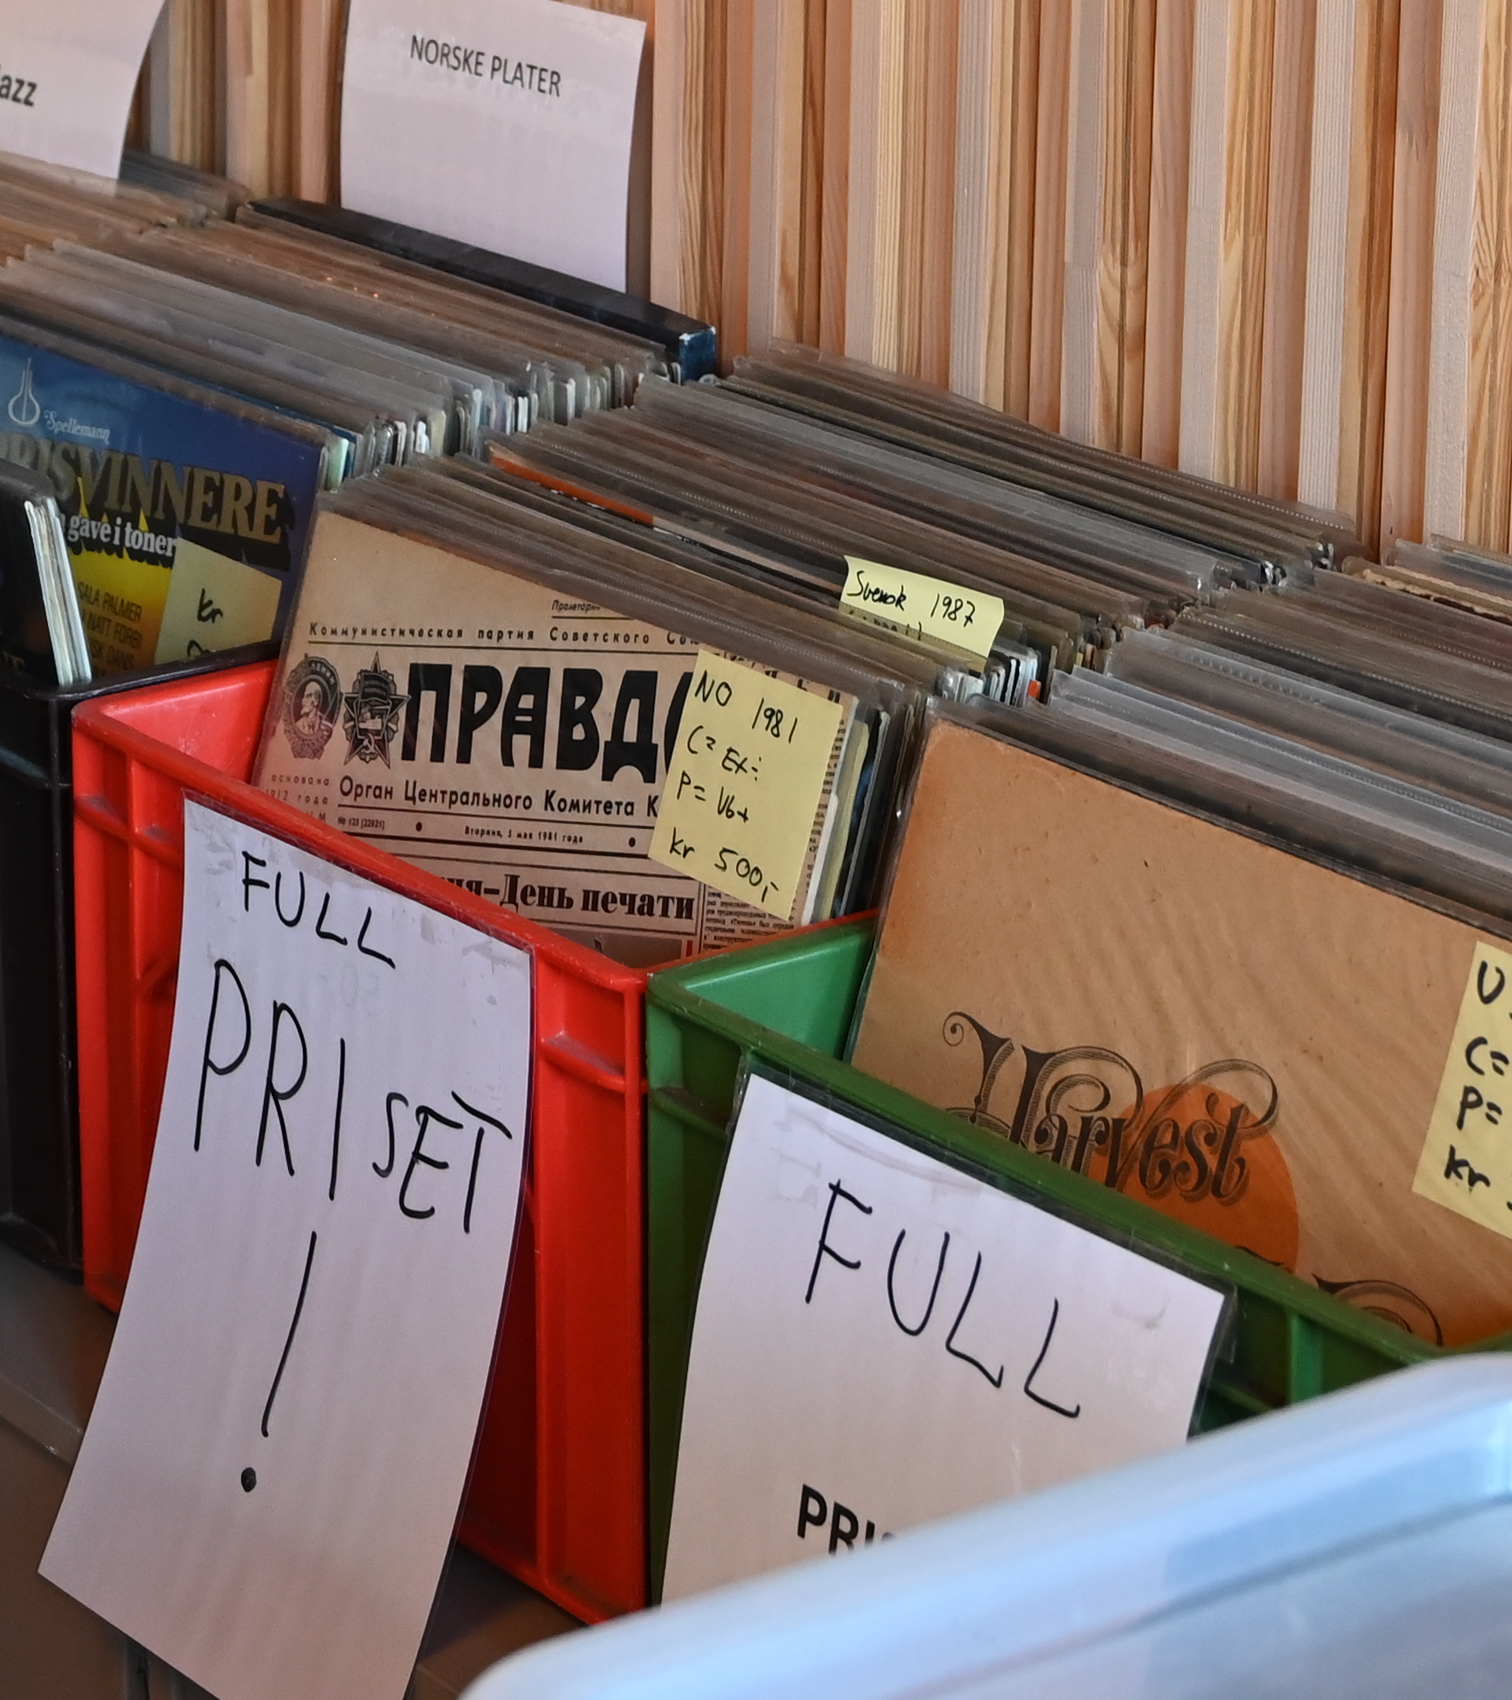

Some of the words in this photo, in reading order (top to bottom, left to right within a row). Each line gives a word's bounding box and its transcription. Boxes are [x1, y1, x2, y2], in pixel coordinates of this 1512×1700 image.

[409, 33, 485, 81] NORSKE
[490, 55, 563, 99] PLATER
[67, 515, 111, 546] gave
[113, 516, 121, 545] i
[125, 521, 176, 558] toner
[930, 593, 976, 628] 1987
[309, 622, 463, 639] Коммунистическая
[478, 627, 535, 643] партия
[549, 627, 650, 645] Советского
[694, 669, 733, 707] NO
[752, 697, 798, 744] 1981
[297, 793, 329, 806] года
[339, 774, 393, 802] Орган
[404, 780, 533, 811] Центрального
[544, 789, 635, 818] Комитета
[537, 830, 558, 842] 1981
[562, 833, 584, 844] года
[242, 850, 396, 970] FULL
[581, 887, 696, 921] печати
[194, 957, 513, 1235] PRISET
[942, 1011, 1278, 1206] Harvest
[804, 1178, 1081, 1419] FULL
